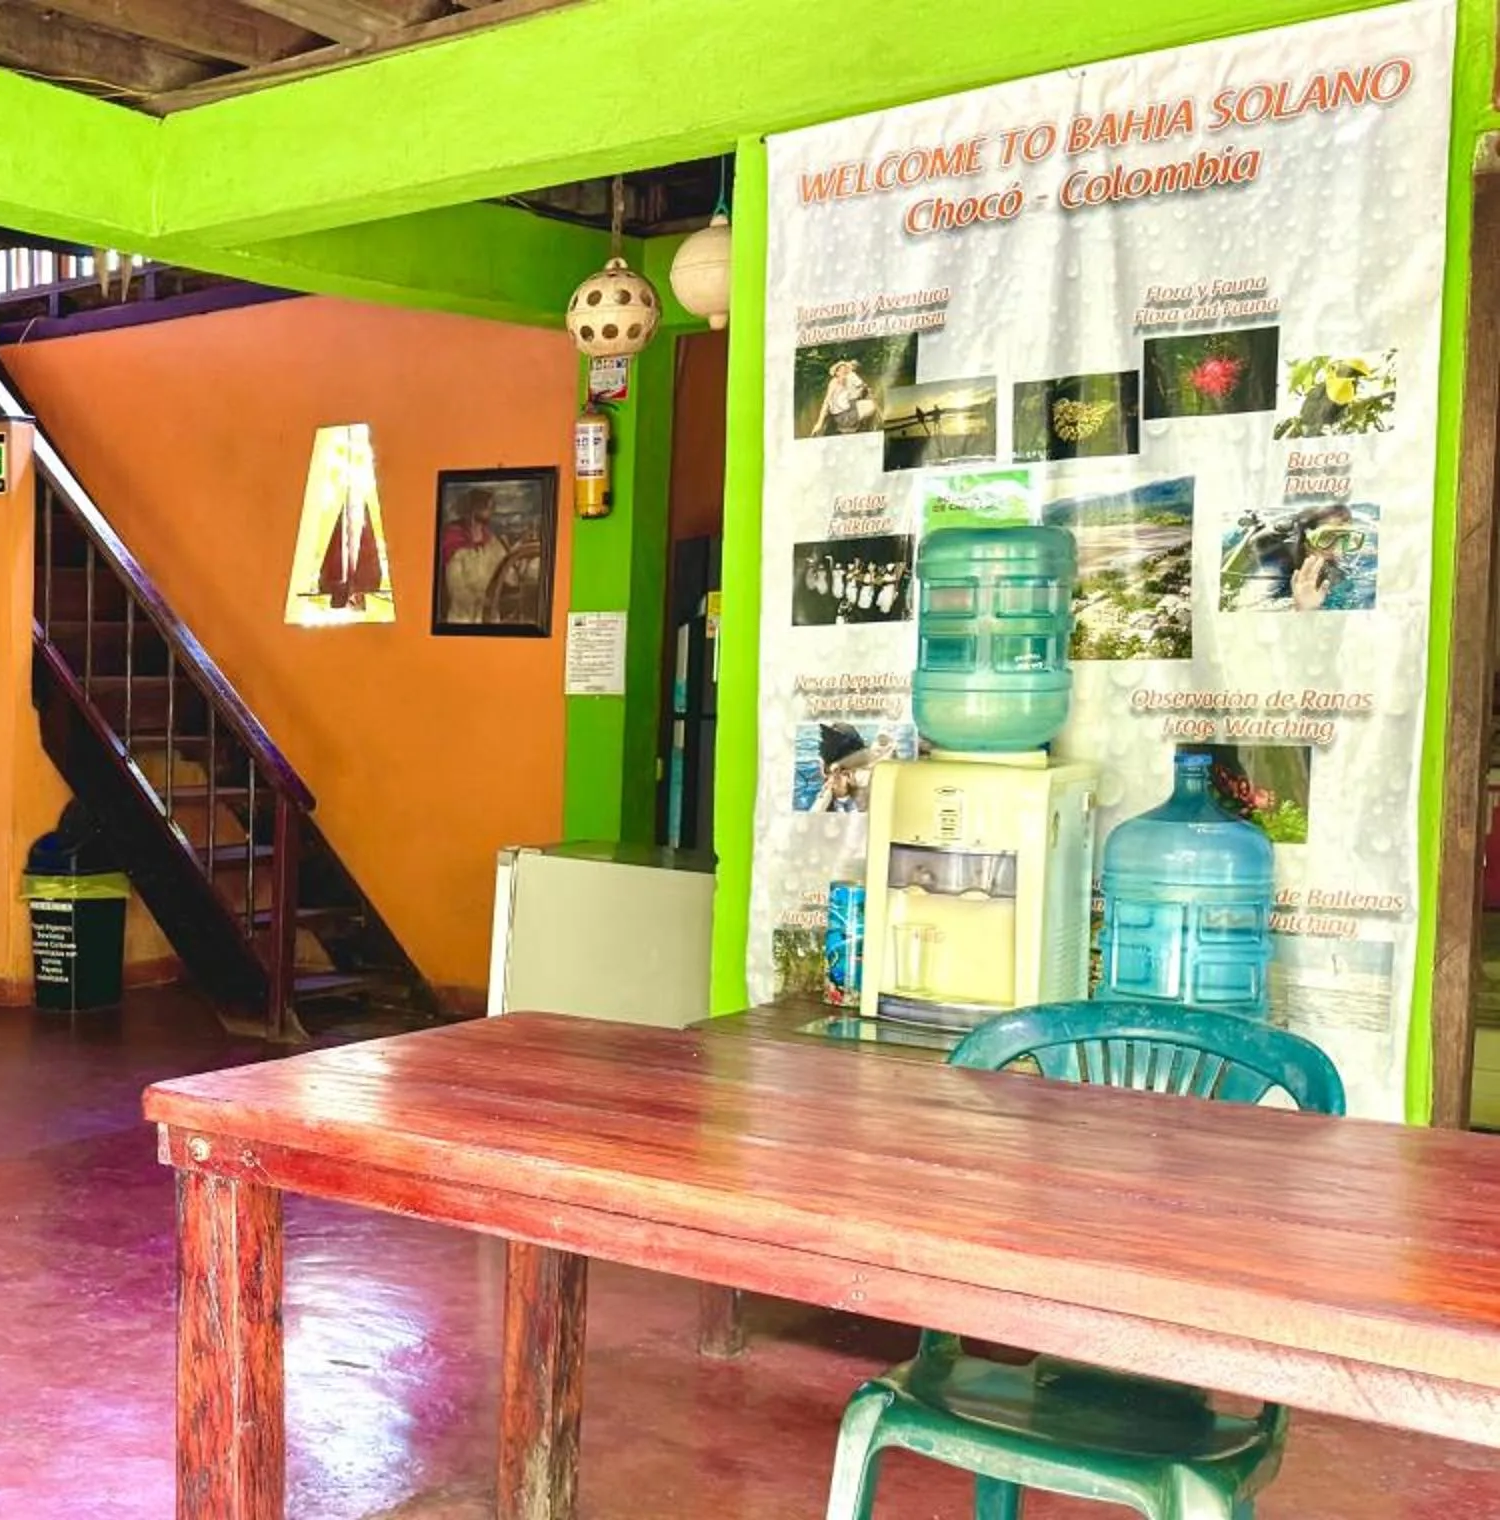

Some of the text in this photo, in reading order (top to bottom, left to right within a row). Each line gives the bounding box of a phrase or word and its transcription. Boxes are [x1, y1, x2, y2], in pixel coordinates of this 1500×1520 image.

[800, 58, 1412, 204] WELCOME TO BAHIA SOLANO
[906, 182, 1023, 234] Chocó
[1061, 145, 1260, 208] Colombia
[1145, 284, 1192, 301] Flora
[1211, 276, 1268, 295] Fauna
[796, 300, 857, 323] Turismo
[874, 287, 950, 310] Aventura
[1133, 297, 1280, 325] Flora and Fauna
[796, 311, 947, 345] Adventure Tourism
[1287, 451, 1350, 469] Buceo
[1284, 474, 1351, 497] Diving
[1265, 689, 1296, 709] de
[1300, 688, 1375, 710] Ranas
[1162, 716, 1336, 744] Frogs Watching
[1275, 888, 1406, 911] de Ballenas
